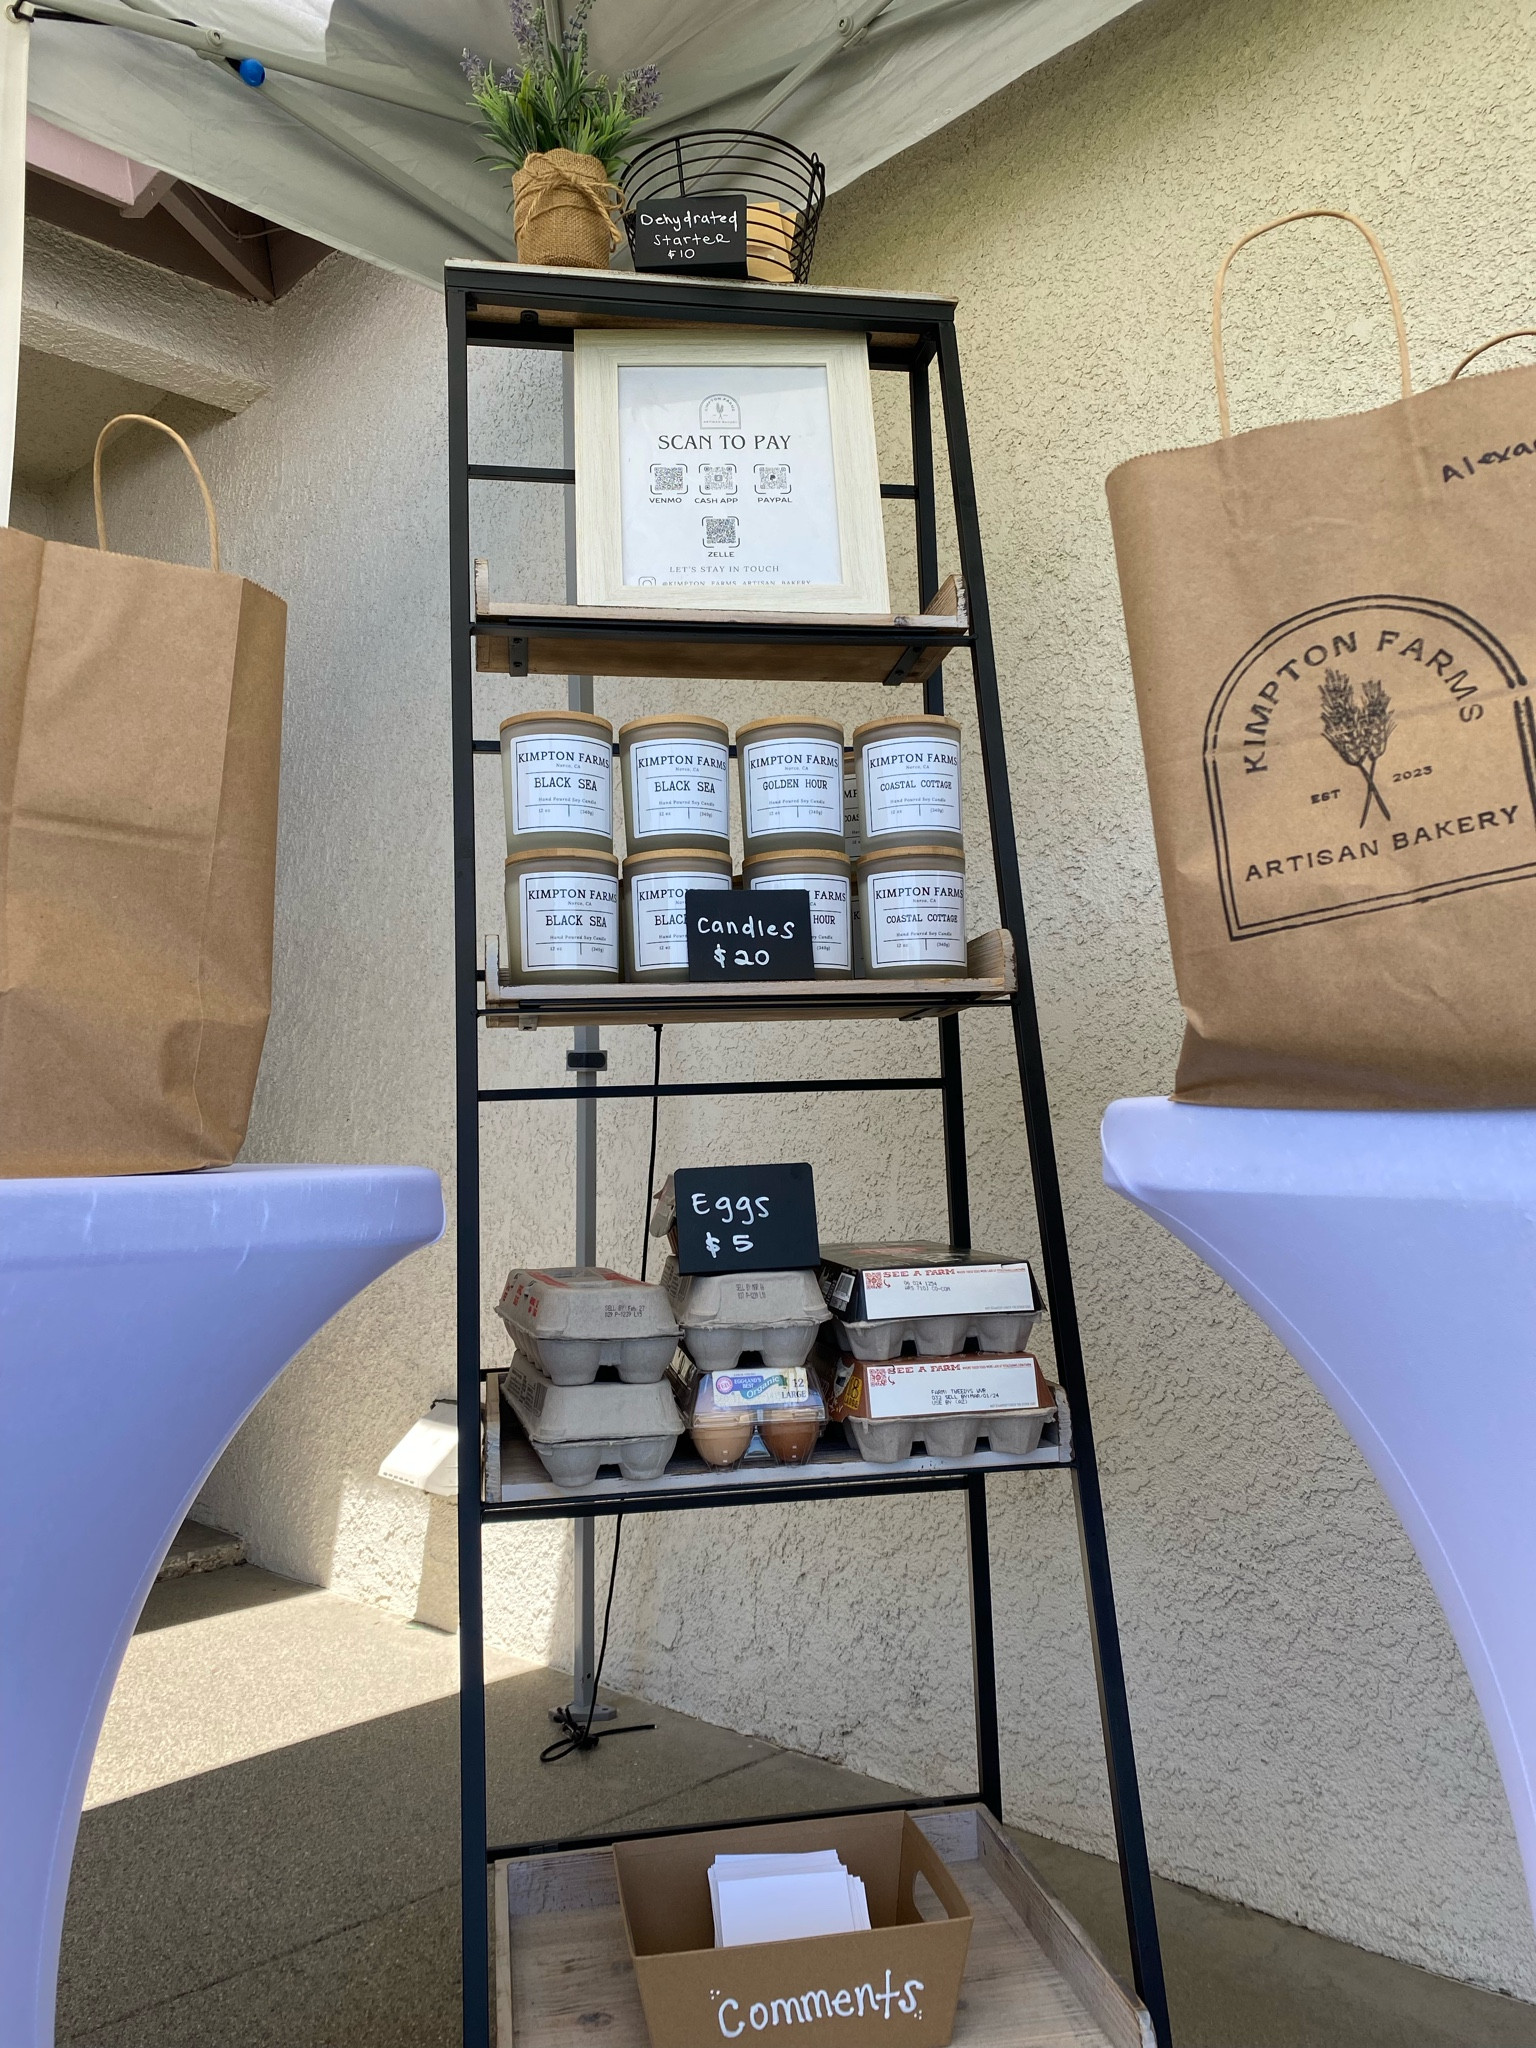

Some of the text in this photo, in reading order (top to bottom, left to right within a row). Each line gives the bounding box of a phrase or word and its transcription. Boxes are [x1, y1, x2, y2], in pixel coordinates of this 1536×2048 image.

[641, 211, 738, 232] Dehydrated
[658, 435, 791, 450] SCAN TO PAY
[1442, 440, 1536, 483] Alexa
[744, 565, 779, 573] TOUCH
[1243, 630, 1484, 775] KIMPTON FARMS
[518, 751, 610, 769] KIMPTON FARMS
[638, 756, 726, 771] KIMPTON FARMS
[750, 755, 839, 770] KIMPTON FARMS
[870, 753, 958, 769] KIMPTON FARMS
[534, 777, 597, 791] BLACK SEA
[655, 781, 716, 794] BLACK SEA
[763, 779, 828, 791] GOLDEN HOUR
[880, 780, 952, 792] COASTAL COTTAGE
[1311, 765, 1434, 805] EST 2023
[1245, 805, 1519, 882] ARTISAN BAKERY
[528, 889, 617, 903] KIMPTON FARMS
[815, 891, 846, 902] FARMS
[876, 887, 964, 900] KIMPTON FARMS
[546, 915, 607, 928] BLACK SEA
[813, 915, 836, 925] HOUR
[886, 914, 958, 924] COASTAL COTTAGE
[697, 916, 795, 939] Candles
[691, 1193, 770, 1225] Eggs
[888, 1366, 915, 1374] SEE
[931, 1364, 961, 1373] FARM
[747, 1376, 780, 1398] Organic
[793, 1379, 804, 1387] 12
[781, 1391, 806, 1399] LARGE
[718, 1969, 925, 2038] Comments
